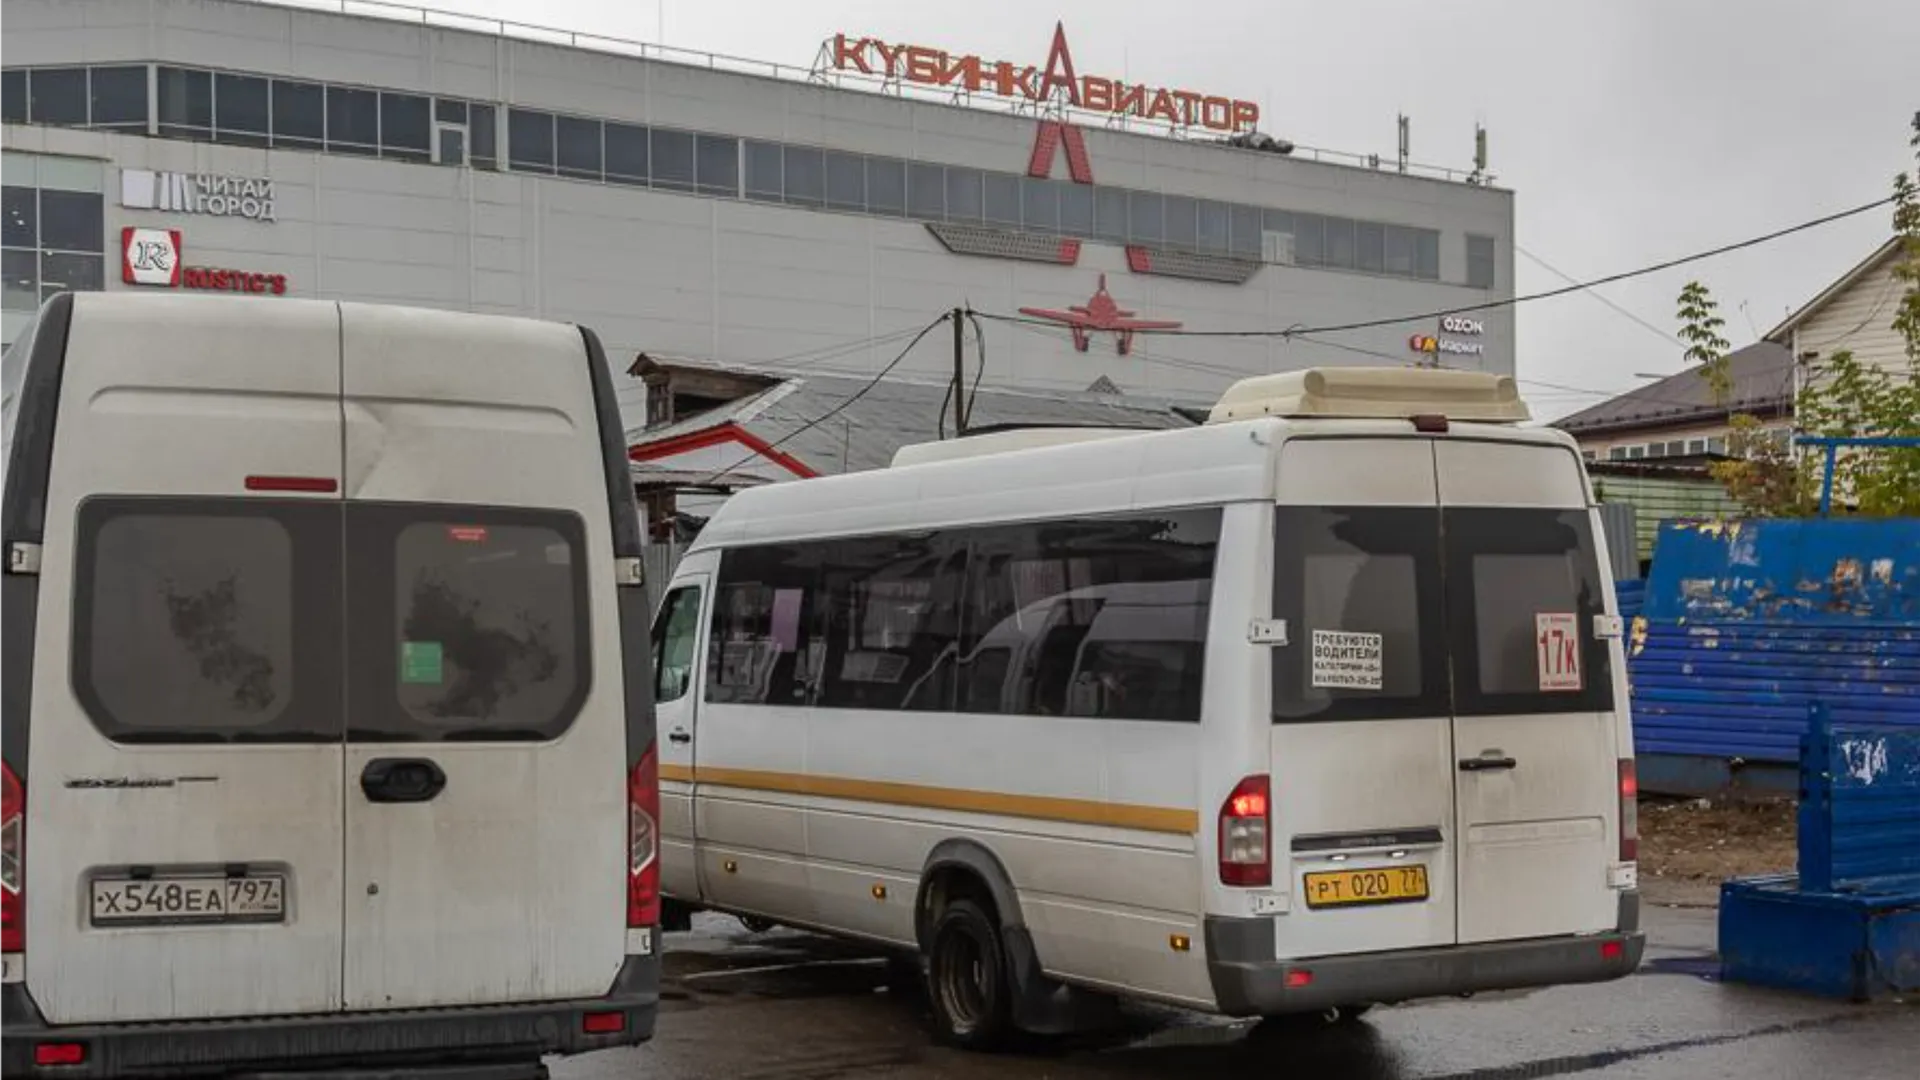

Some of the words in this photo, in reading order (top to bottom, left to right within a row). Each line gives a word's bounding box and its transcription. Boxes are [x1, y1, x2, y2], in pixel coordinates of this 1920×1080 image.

[196, 173, 276, 199] ЧИТАЙ
[196, 196, 278, 223] ГОРОД
[183, 266, 288, 295] ROSTIC'S
[1443, 316, 1484, 333] OZON
[1314, 633, 1380, 647] ТРЕБУЮТСЯ
[1314, 645, 1379, 660] ВОДИТЕЛИ
[1318, 880, 1342, 899] РТ
[1351, 872, 1389, 896] 020
[1400, 867, 1418, 892] 77
[104, 883, 223, 913] Х548ЕА
[229, 881, 273, 902] 797
